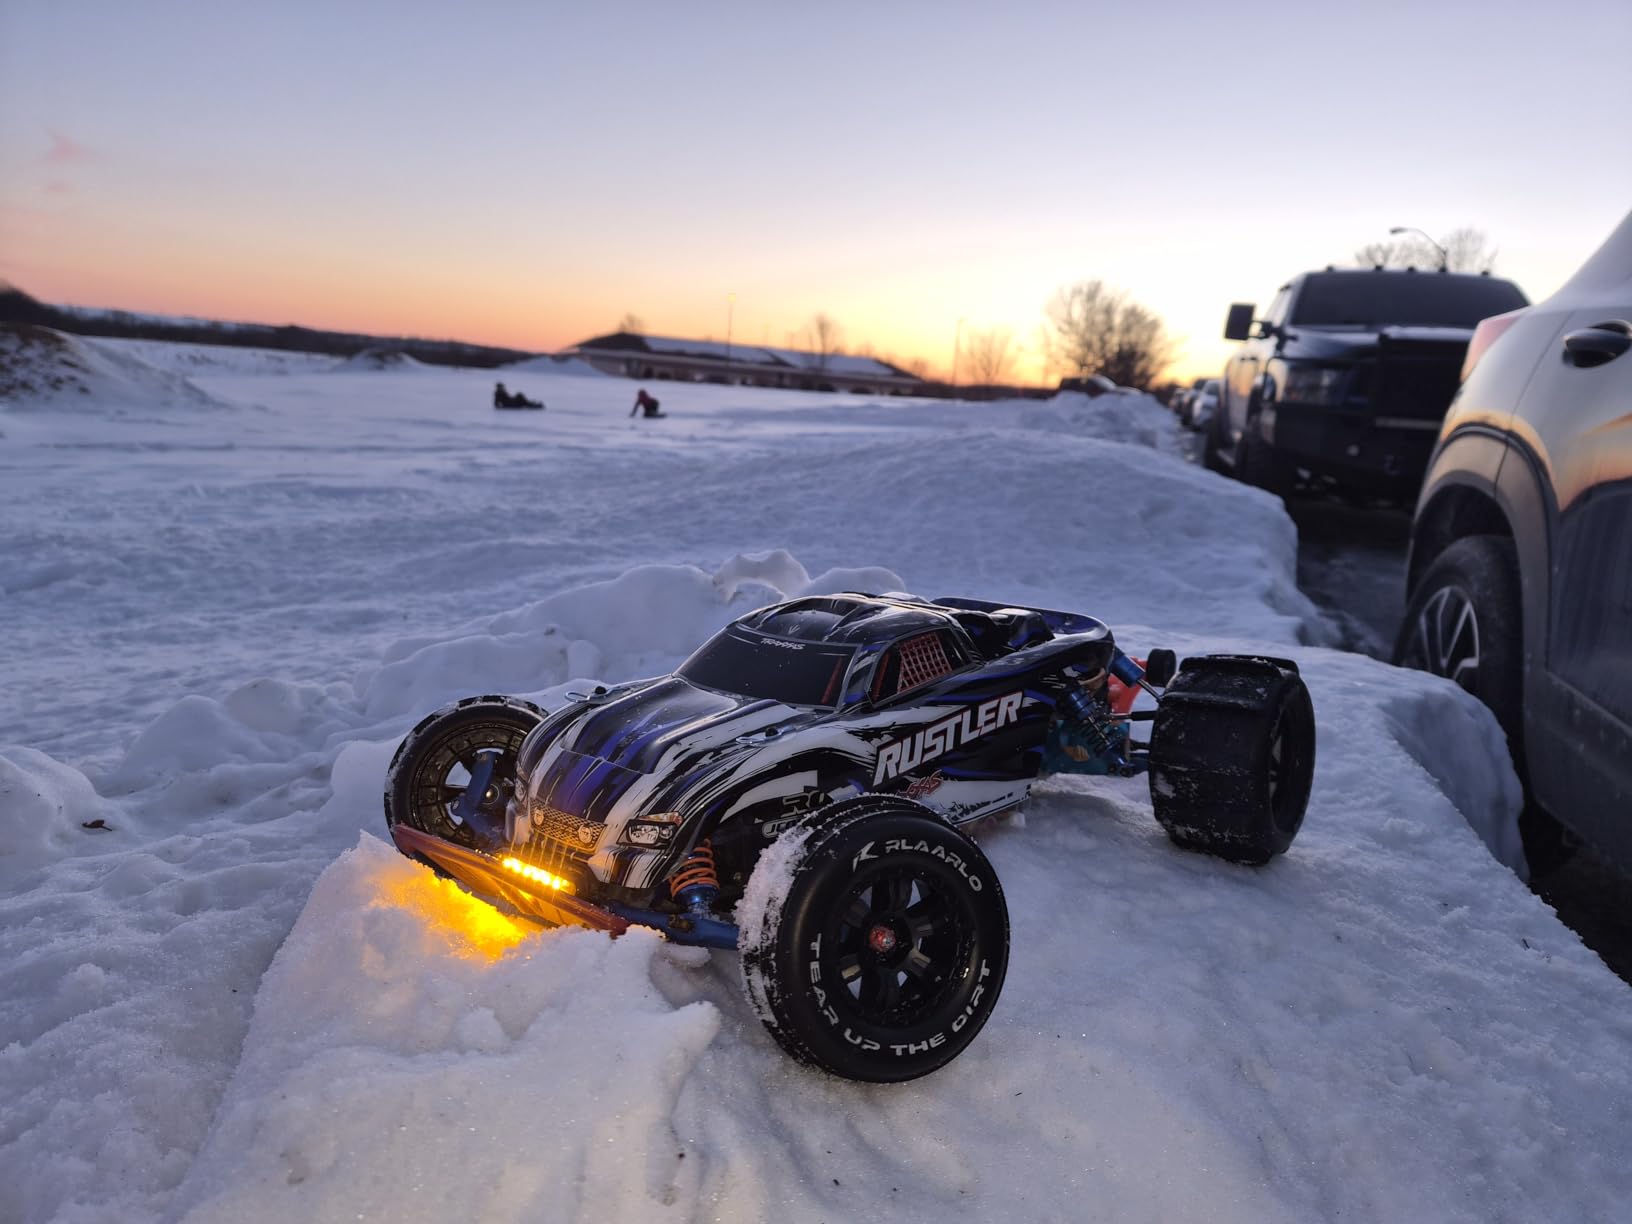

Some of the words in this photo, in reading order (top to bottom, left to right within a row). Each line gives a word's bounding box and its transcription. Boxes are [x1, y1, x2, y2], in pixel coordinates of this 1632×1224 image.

[872, 691, 1023, 787] RUSTLER
[885, 838, 983, 892] RLAARLO
[810, 932, 840, 1026] TEAR
[843, 1028, 881, 1051] UP
[889, 1032, 946, 1056] THE
[951, 959, 991, 1033] DIRT
